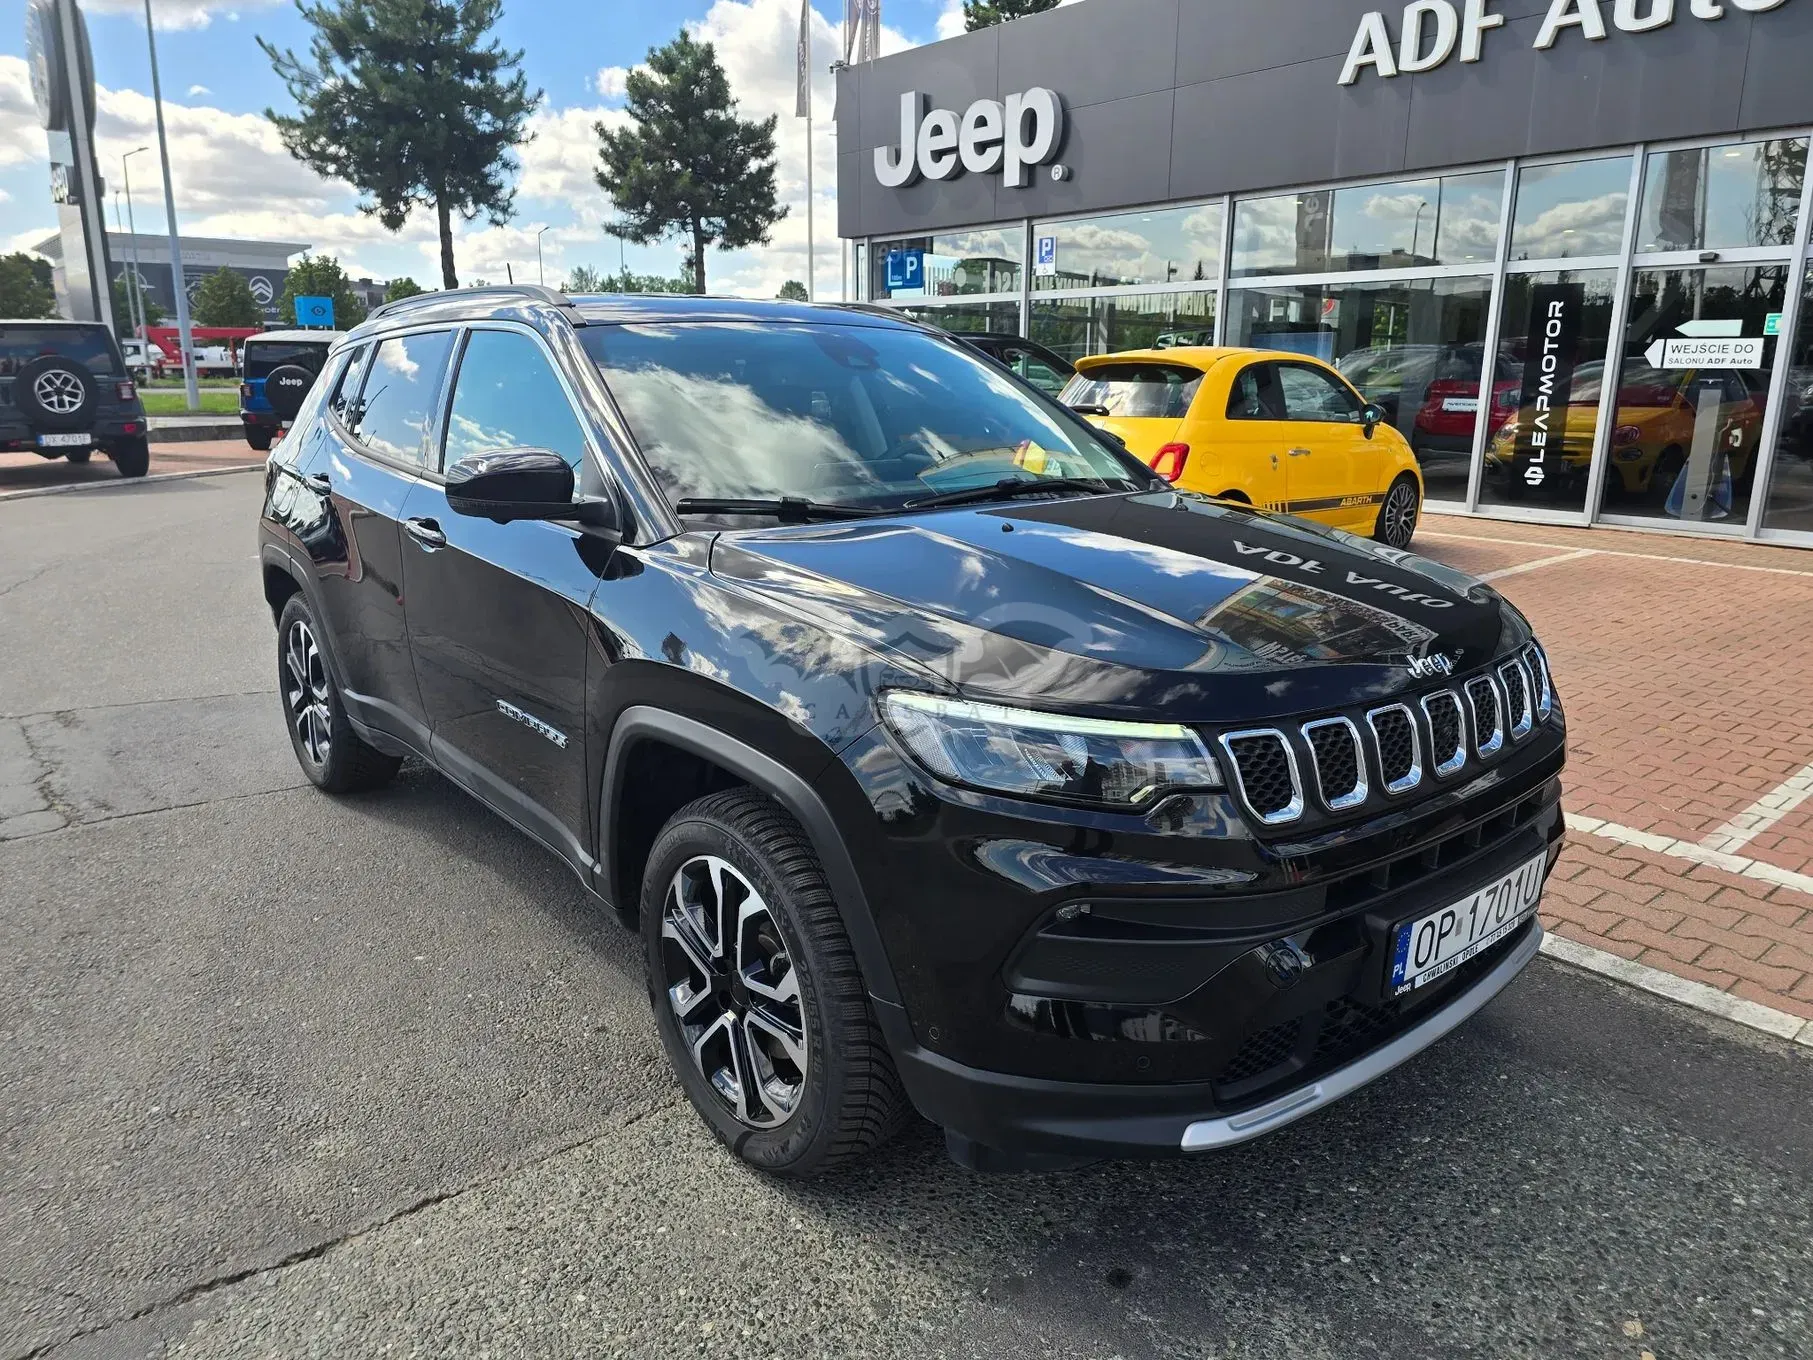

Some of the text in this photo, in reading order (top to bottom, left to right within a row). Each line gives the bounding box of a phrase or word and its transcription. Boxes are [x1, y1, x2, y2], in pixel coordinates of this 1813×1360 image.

[1337, 0, 1505, 86] ADF
[874, 87, 1063, 188] Jeep
[906, 256, 918, 279] P
[1671, 341, 1755, 355] WEJŚCIE DO
[1667, 357, 1753, 365] SALONU ADF Auto
[280, 377, 303, 387] Jeep
[1529, 301, 1565, 463] LEAPMOTOR
[1340, 496, 1373, 506] ABARTH
[1405, 653, 1452, 679] Jeep
[1414, 859, 1542, 969] OP 1701U
[1461, 944, 1479, 961] OPOLE
[1392, 964, 1404, 978] PL
[1394, 982, 1412, 996] Jeep
